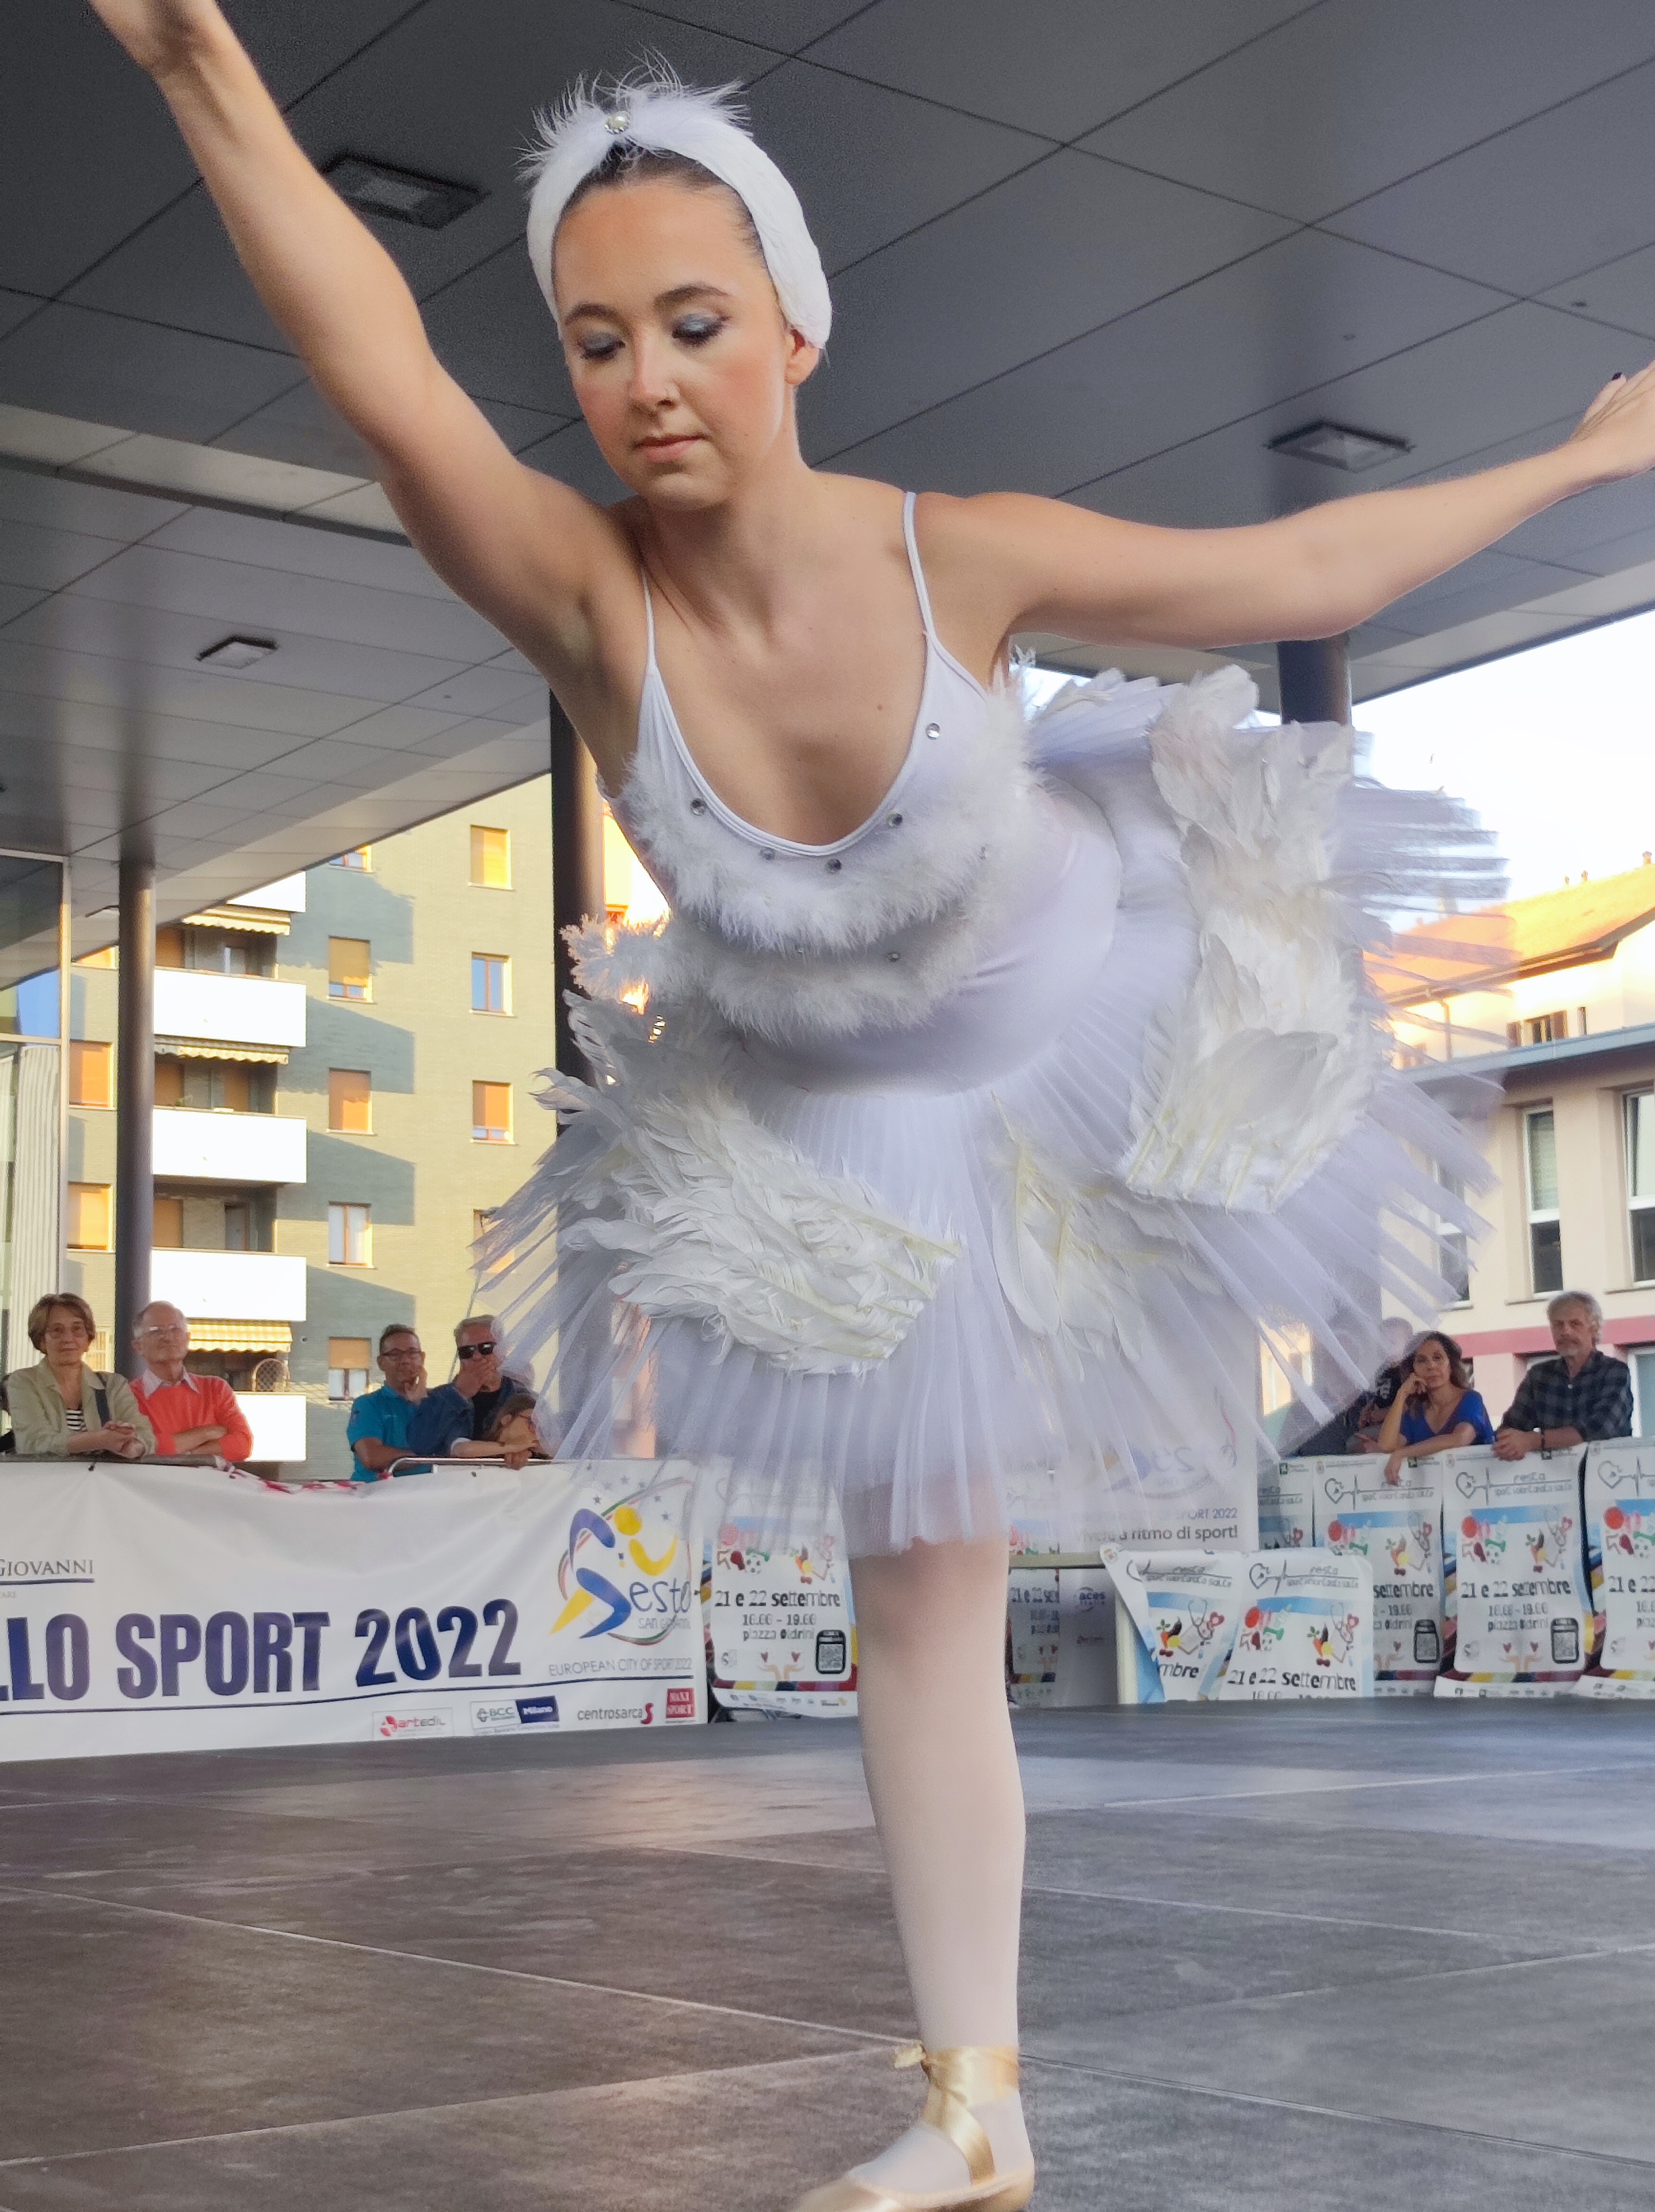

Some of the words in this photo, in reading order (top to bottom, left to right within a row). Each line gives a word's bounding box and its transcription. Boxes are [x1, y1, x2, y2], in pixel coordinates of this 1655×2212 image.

[1461, 1582, 1478, 1598] 21
[1481, 1584, 1490, 1598] e
[1492, 1580, 1509, 1598] 22
[1628, 1578, 1636, 1593] e
[715, 1590, 731, 1607] 21
[736, 1592, 745, 1607] e
[748, 1590, 767, 1607] 22
[771, 1590, 841, 1607] settembre
[0, 1613, 90, 1701] LO
[115, 1611, 330, 1699] SPORT
[355, 1599, 521, 1687] 2022
[548, 1659, 615, 1676] EUROPEAN
[618, 1658, 638, 1671] CITY
[1226, 1669, 1244, 1685] 21
[1248, 1671, 1257, 1685] e
[1258, 1668, 1277, 1684] 22
[1281, 1670, 1356, 1691] settembre
[489, 1707, 515, 1717] BCC
